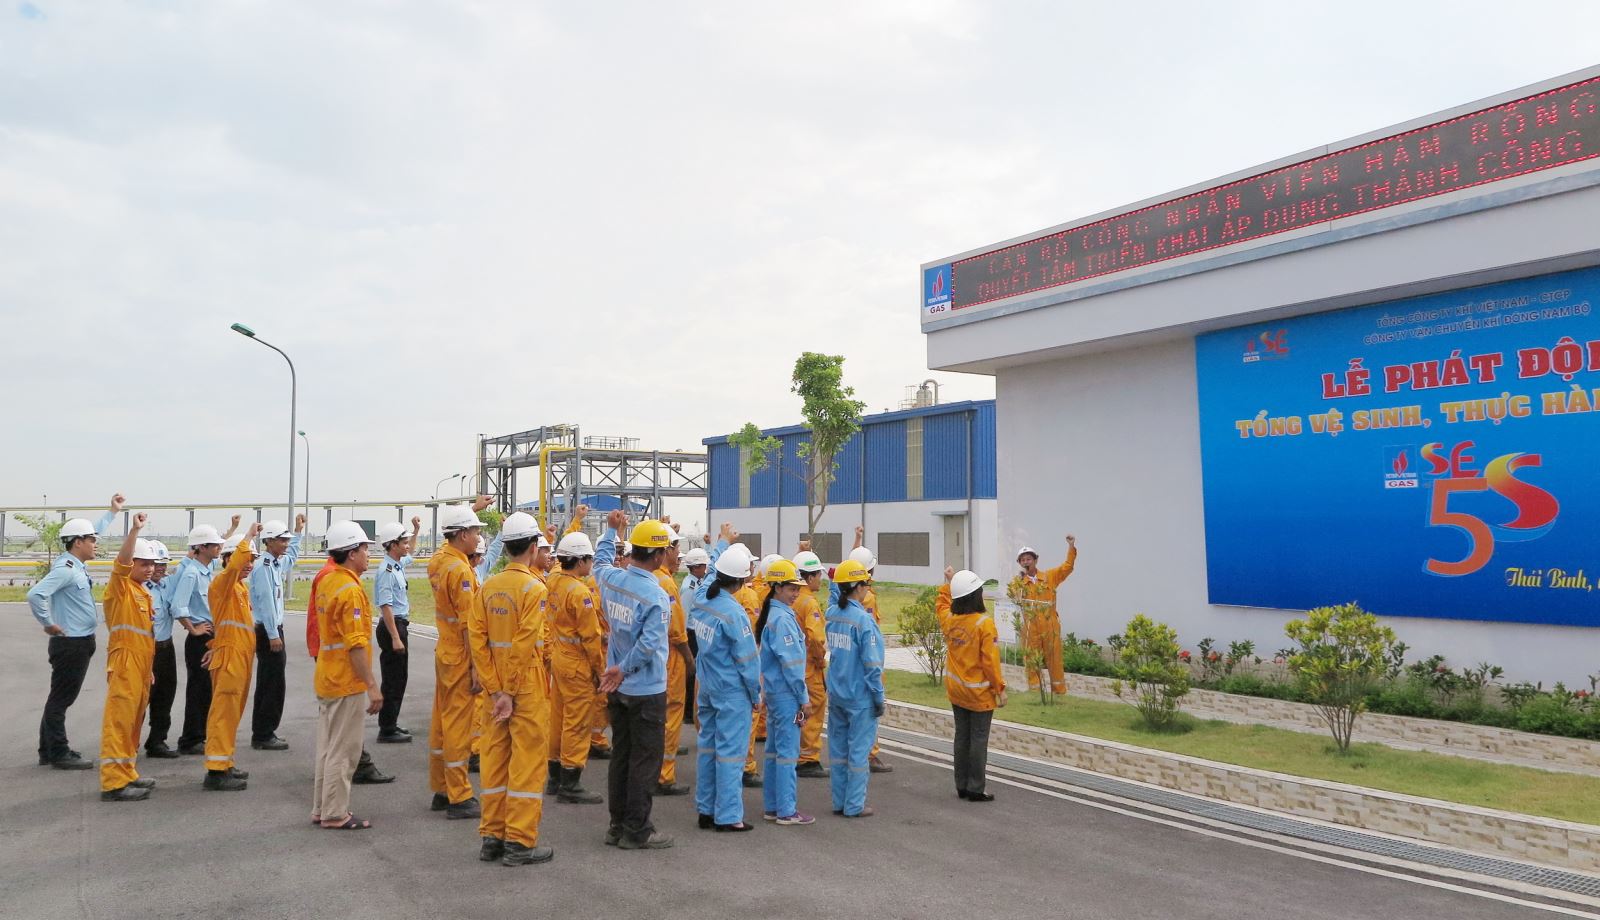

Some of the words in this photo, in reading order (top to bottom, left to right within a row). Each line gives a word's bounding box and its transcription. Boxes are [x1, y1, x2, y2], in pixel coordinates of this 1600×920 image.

[1156, 225, 1207, 255] KHAI
[930, 304, 946, 313] GAS
[1441, 308, 1451, 318] TY
[1501, 296, 1528, 308] NAM
[1539, 289, 1571, 303] CTCP
[1364, 332, 1394, 345] CÔNG
[1397, 329, 1409, 341] TY
[1542, 306, 1571, 319] NAM
[1322, 358, 1372, 399] LỄ
[1384, 350, 1502, 393] PHÁT
[1236, 410, 1302, 438] TỔNG
[1309, 408, 1344, 437] VỆ
[1352, 405, 1432, 430] SINH,
[1440, 390, 1531, 425] THỰC
[1388, 480, 1415, 488] GAS
[1504, 567, 1543, 588] Thái
[1546, 567, 1592, 593] Bình,
